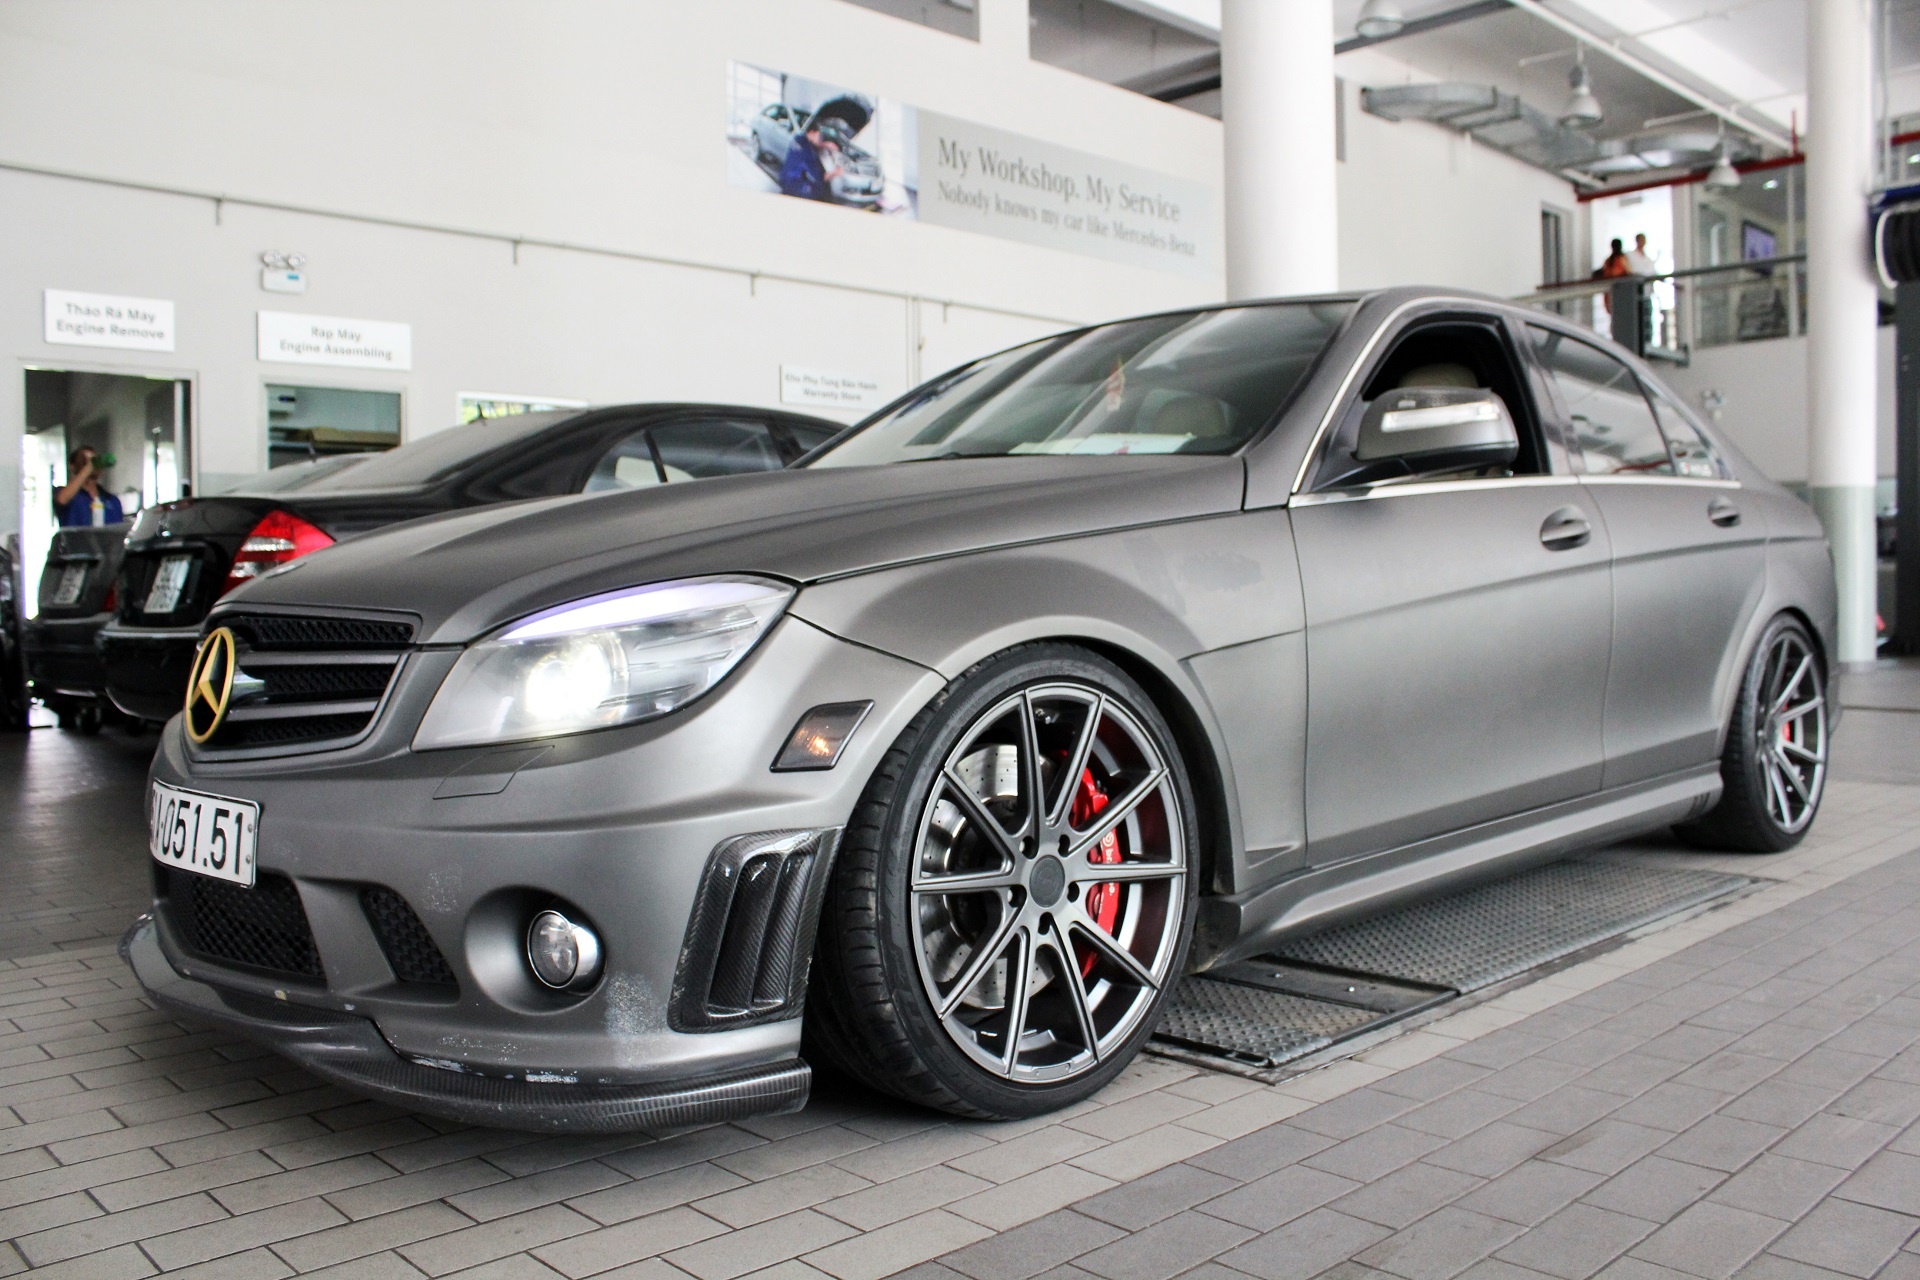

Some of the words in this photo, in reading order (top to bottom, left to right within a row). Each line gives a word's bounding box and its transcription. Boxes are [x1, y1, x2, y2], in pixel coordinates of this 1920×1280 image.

[938, 136, 971, 178] My
[978, 146, 1080, 203] Workshop.
[1086, 174, 1113, 211] My
[1119, 183, 1181, 222] Service
[938, 179, 990, 214] Nobody
[995, 193, 1038, 220] knows
[1041, 208, 1060, 230] my
[1063, 214, 1083, 231] car
[1087, 214, 1109, 236] like
[56, 319, 105, 336] Engine
[110, 323, 165, 340] Remove
[279, 339, 320, 354] Engine
[324, 344, 393, 361] Assembling
[803, 387, 839, 400] Warranty
[841, 390, 862, 401] Store
